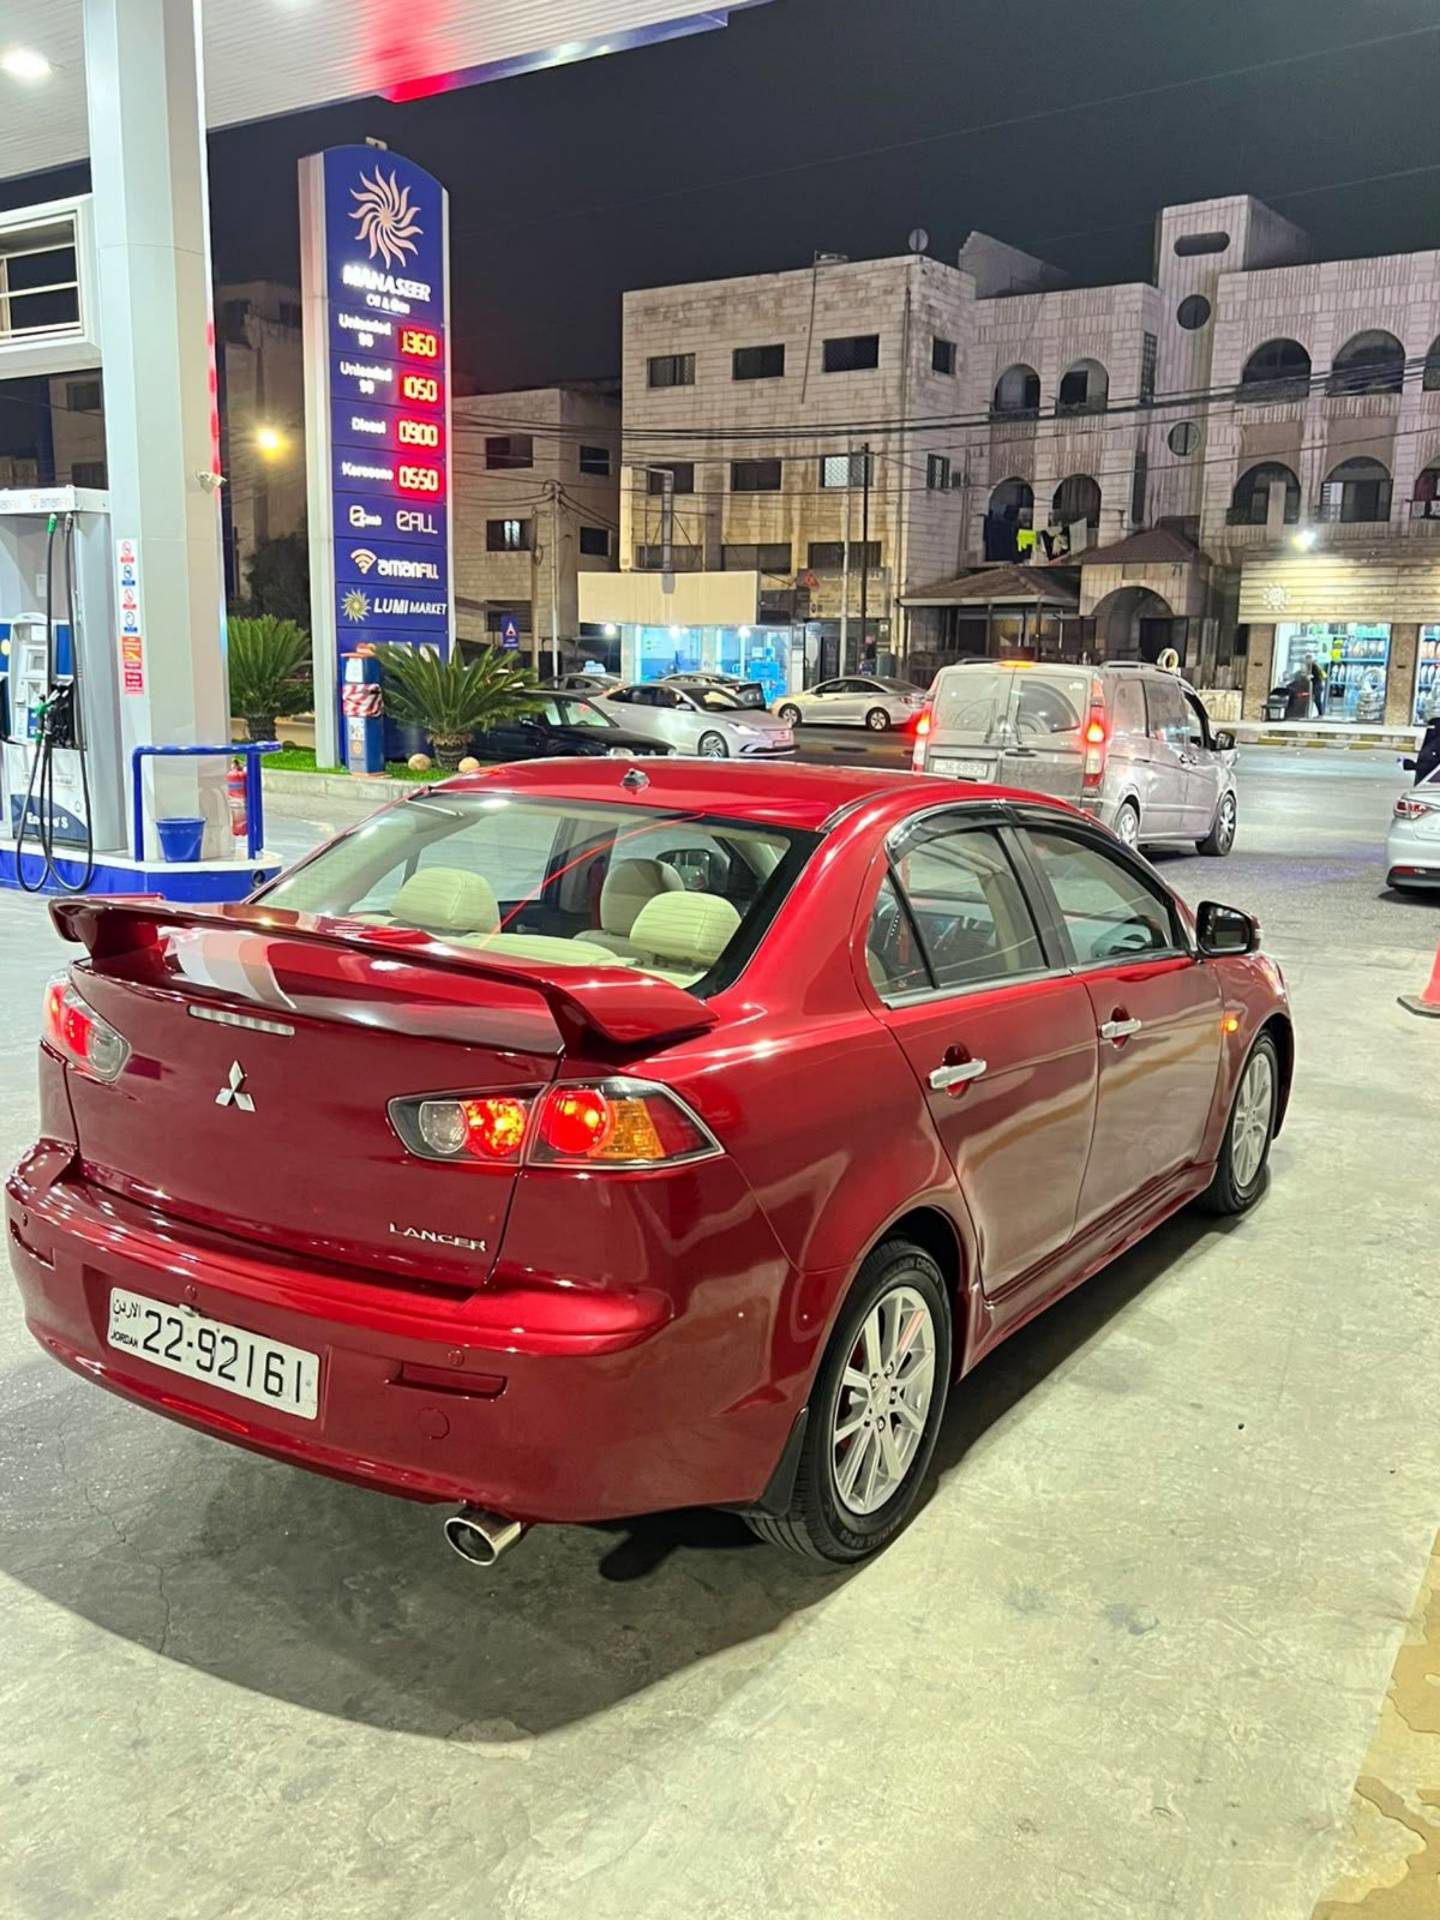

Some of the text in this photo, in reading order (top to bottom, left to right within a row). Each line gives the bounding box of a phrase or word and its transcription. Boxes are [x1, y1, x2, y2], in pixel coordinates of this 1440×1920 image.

[404, 376, 438, 402] 1050
[399, 420, 438, 448] 0900
[374, 598, 447, 616] LUMI MARKET
[389, 1222, 487, 1253] LANCER
[111, 1330, 139, 1348] JORDAN
[143, 1309, 303, 1404] 22-92161
